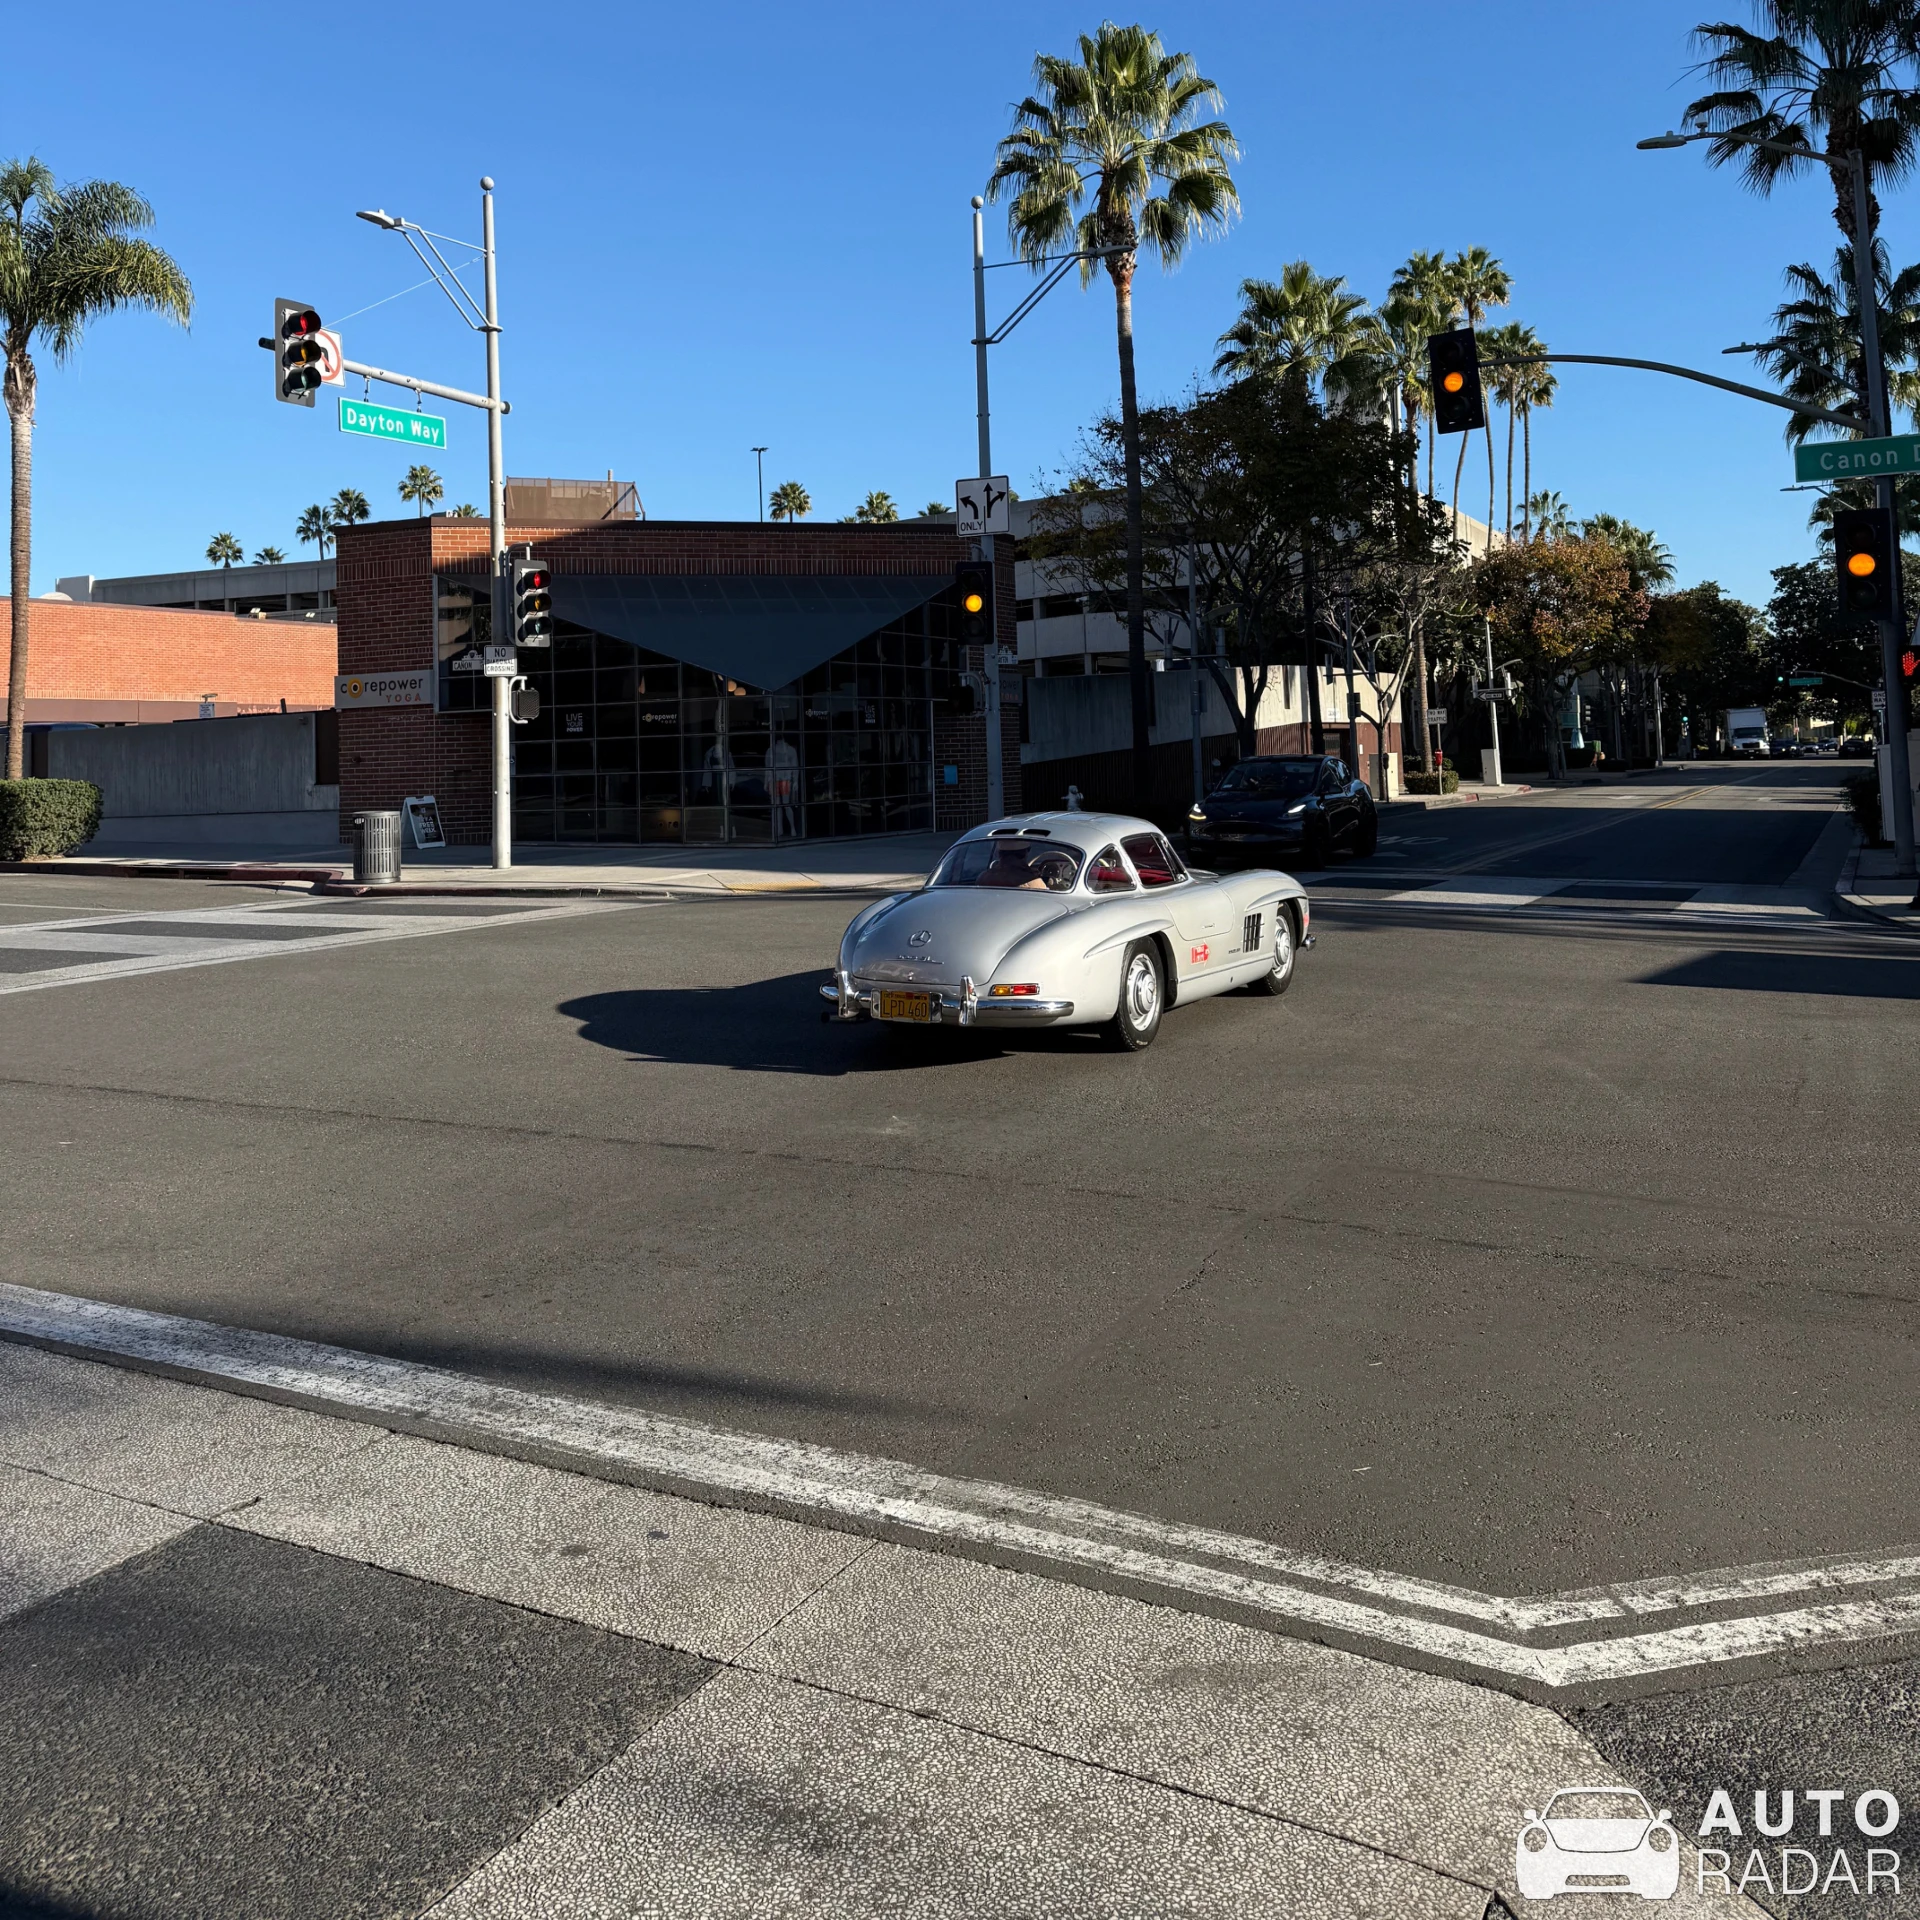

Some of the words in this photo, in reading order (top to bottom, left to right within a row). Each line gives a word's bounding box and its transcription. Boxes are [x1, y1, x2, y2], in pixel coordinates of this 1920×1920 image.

[347, 407, 404, 433] Dayton
[410, 419, 439, 444] Way
[1820, 450, 1899, 471] Canon
[960, 521, 983, 531] ONLY
[494, 647, 507, 657] NO
[340, 678, 423, 698] corepower
[385, 693, 422, 703] YOGA
[565, 712, 584, 722] LIVE
[883, 999, 904, 1018] LPD
[908, 1001, 927, 1018] 460
